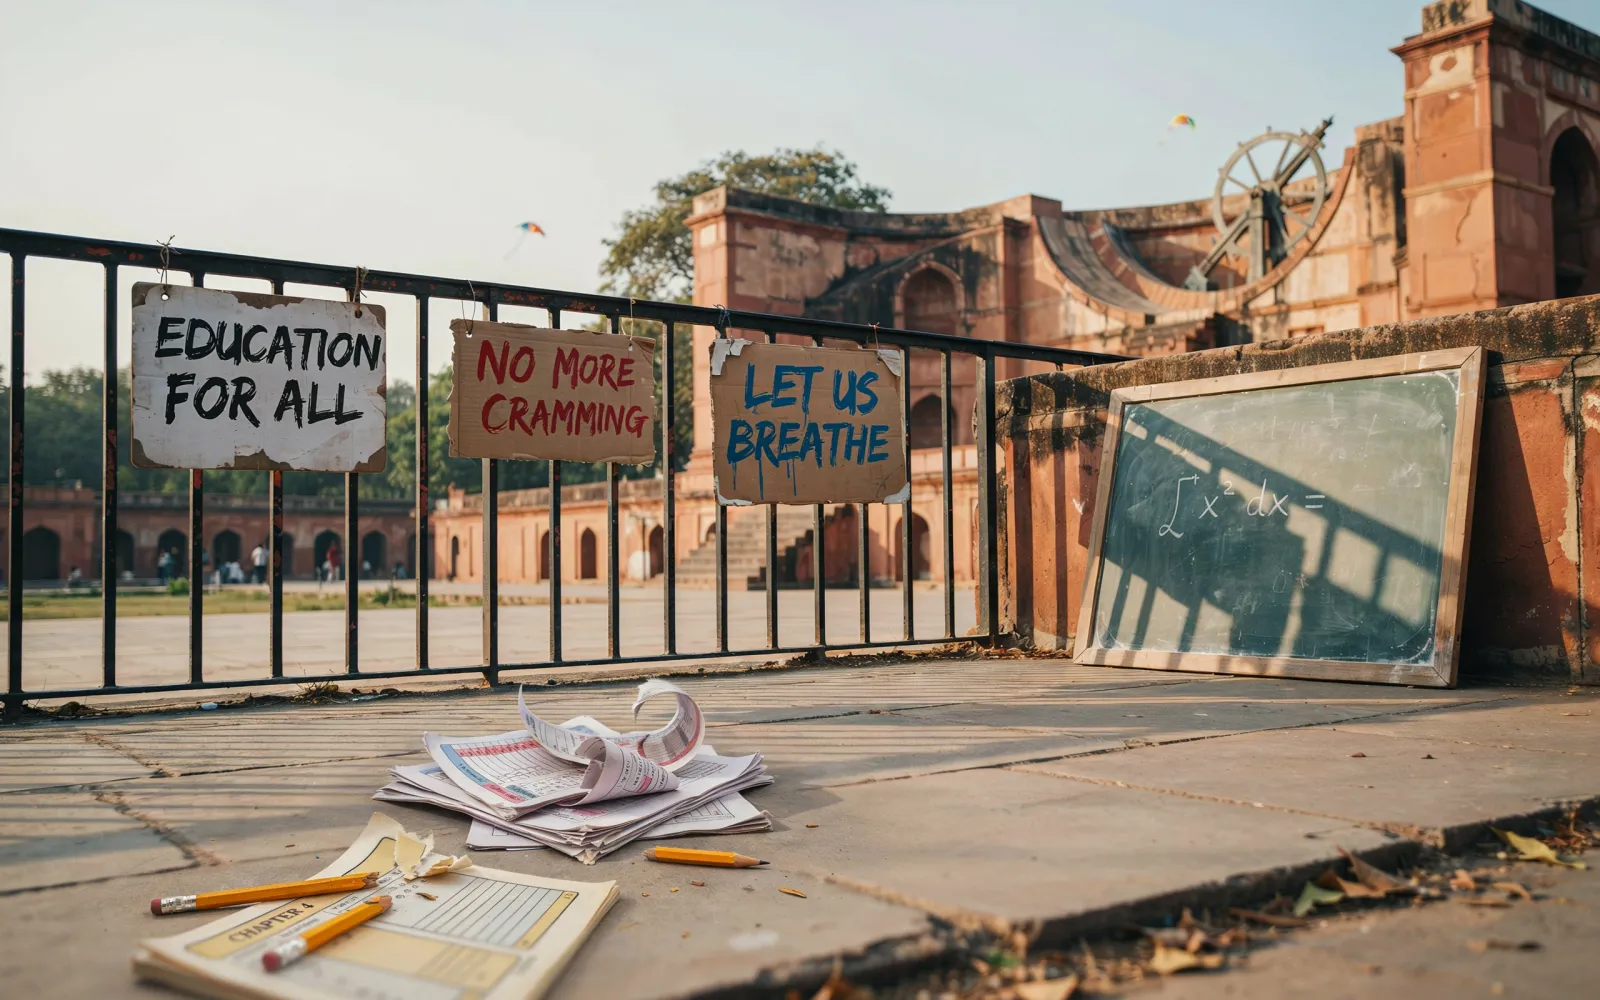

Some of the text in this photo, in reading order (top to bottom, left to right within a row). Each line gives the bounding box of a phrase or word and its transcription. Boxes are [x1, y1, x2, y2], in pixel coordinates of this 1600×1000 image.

[155, 316, 382, 371] EDUCATION
[477, 339, 635, 392] NO MORE
[165, 373, 364, 429] FOR ALL
[744, 362, 879, 416] LET US
[481, 393, 648, 438] CRAMMING
[727, 419, 889, 469] BREATHE
[1246, 478, 1289, 517] dx
[228, 908, 304, 942] CHAPTER
